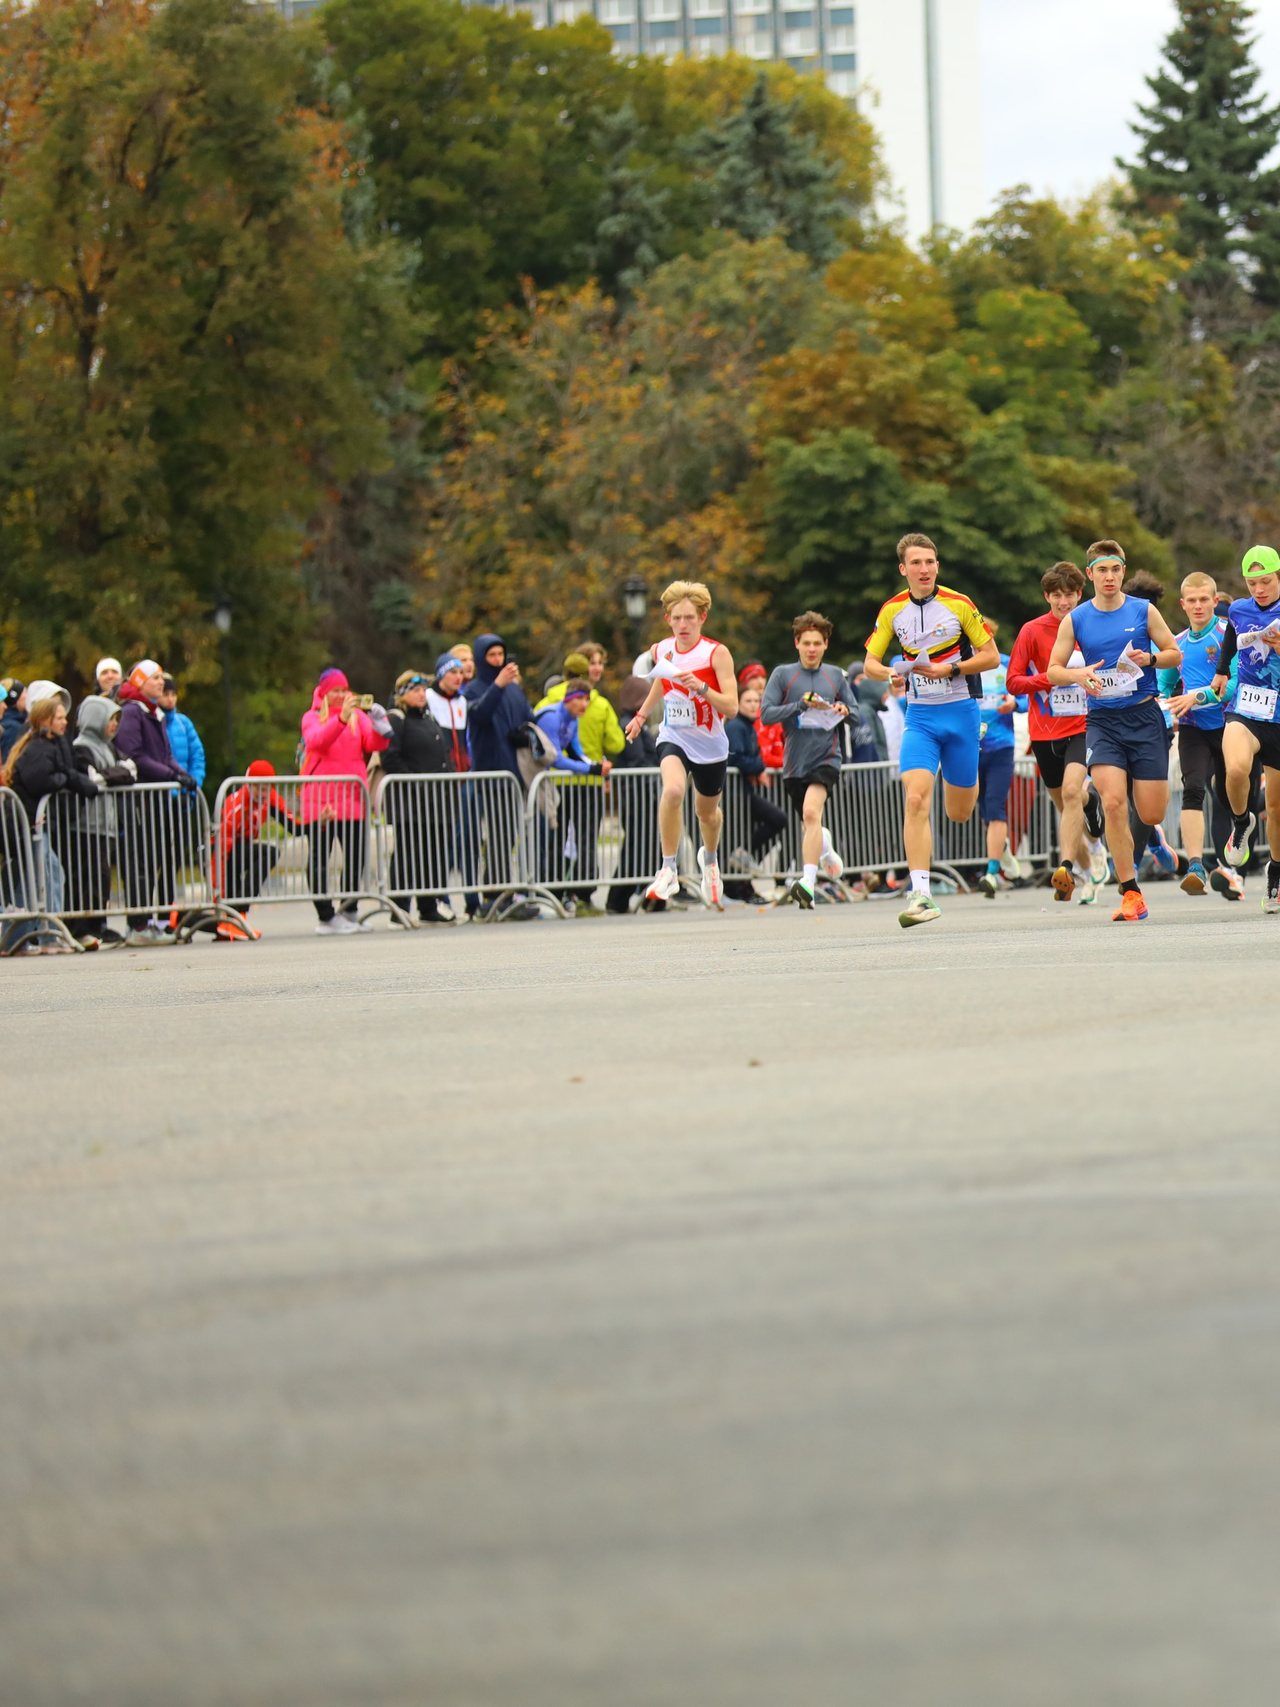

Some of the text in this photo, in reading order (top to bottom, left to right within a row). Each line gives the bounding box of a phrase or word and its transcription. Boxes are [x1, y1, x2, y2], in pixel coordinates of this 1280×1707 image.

[1053, 694, 1080, 704] 232.1
[1241, 690, 1269, 706] 219.1
[668, 708, 690, 717] 229.1
